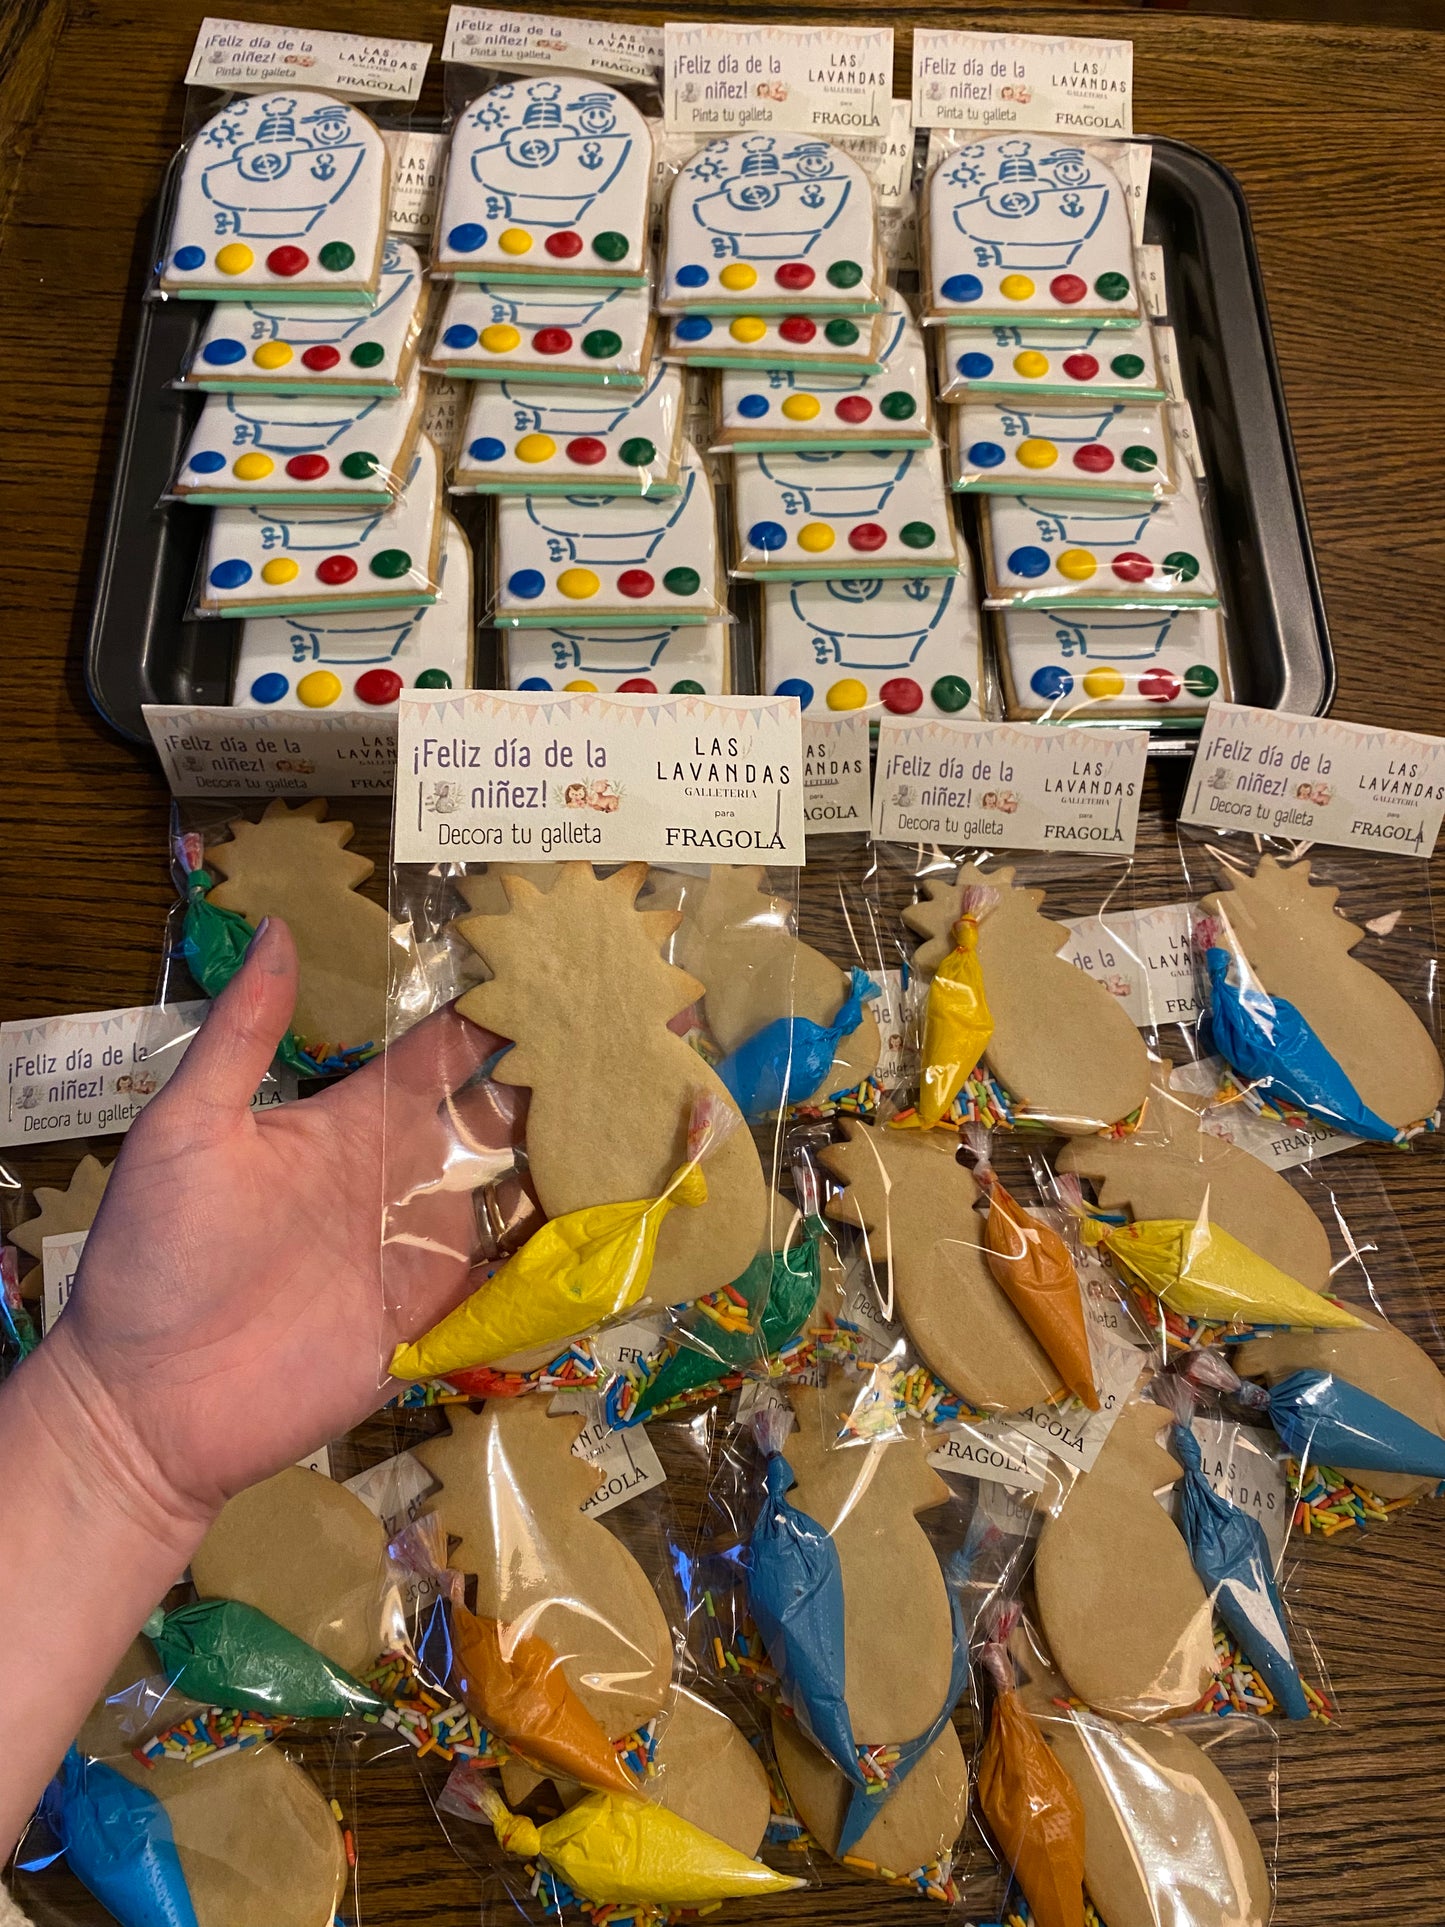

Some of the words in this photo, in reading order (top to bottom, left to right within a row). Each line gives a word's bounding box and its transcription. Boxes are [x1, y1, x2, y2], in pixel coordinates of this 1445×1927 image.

[456, 20, 494, 32] ¡Feliz
[500, 22, 520, 34] día
[528, 25, 544, 36] de
[550, 27, 562, 38] la
[611, 33, 636, 43] LAS
[205, 34, 243, 49] ¡Feliz
[250, 36, 271, 49] día
[277, 38, 294, 50] de
[301, 41, 313, 52] la
[485, 34, 528, 47] niñez!
[588, 37, 664, 57] LAVANDAS
[232, 51, 275, 64] niñez!
[339, 52, 418, 71] LAVANDAS
[364, 47, 390, 58] LAS
[470, 48, 497, 57] Pinta
[501, 49, 513, 57] tu
[516, 50, 552, 60] galleta
[831, 53, 857, 67] LAS
[215, 66, 242, 77] Pinta
[246, 68, 258, 77] tu
[261, 67, 297, 79] galleta
[674, 55, 711, 78] ¡Feliz
[718, 54, 739, 74] día
[746, 55, 763, 73] de
[769, 55, 781, 73] la
[919, 57, 956, 78] ¡Feliz
[963, 59, 984, 77] día
[990, 59, 1007, 77] de
[1014, 61, 1025, 78] la
[1074, 62, 1099, 75] LAS
[337, 75, 407, 94] FRAGOLA
[809, 69, 886, 86] LAVANDAS
[1052, 75, 1127, 93] LAVANDAS
[705, 80, 748, 99] niñez!
[950, 83, 992, 100] niñez!
[692, 108, 719, 122] Pinta
[723, 109, 735, 122] tu
[738, 108, 773, 126] galleta
[813, 111, 880, 127] FRAGOLA
[937, 105, 963, 120] Pinta
[967, 107, 979, 120] tu
[983, 107, 1017, 125] galleta
[1056, 112, 1122, 129] FRAGOLA
[165, 735, 213, 753] ¡Feliz
[221, 737, 248, 753] día
[256, 738, 276, 753] de
[284, 739, 300, 753] la
[362, 736, 396, 747] LAS
[695, 737, 739, 757] LAS
[337, 749, 397, 760] LAVAN
[413, 739, 481, 775] ¡Feliz
[495, 738, 531, 768] día
[545, 740, 573, 768] de
[587, 740, 606, 768] la
[806, 744, 826, 758] AS
[1206, 738, 1253, 762] ¡Feliz
[1258, 746, 1283, 767] día
[1291, 751, 1310, 771] de
[1317, 754, 1332, 775] la
[212, 757, 264, 773] niñez!
[657, 762, 790, 785] LAVANDAS
[804, 760, 862, 776] ANDAS
[886, 755, 931, 780] ¡Feliz
[939, 757, 964, 779] día
[972, 759, 991, 780] de
[1000, 760, 1014, 781] la
[1072, 761, 1103, 776] LAS
[1389, 761, 1418, 778] LAS
[196, 776, 241, 789] Decora
[245, 778, 261, 789] tu
[266, 777, 307, 792] galleta
[684, 787, 757, 799] GALLETERIA
[1045, 779, 1135, 796] LAVANDAS
[1236, 773, 1288, 797] niñez!
[1359, 775, 1445, 800] LAVANDAS
[471, 780, 547, 809] niñez!
[921, 788, 972, 809] niñez!
[714, 810, 735, 819] para
[803, 805, 859, 821] AGOLA
[1210, 796, 1252, 817] Decora
[1257, 804, 1270, 819] tu
[1274, 806, 1314, 828] galleta
[898, 814, 940, 831] Decora
[945, 818, 959, 833] tu
[964, 818, 1004, 839] galleta
[1044, 825, 1124, 842] FRAGOLA
[1351, 820, 1424, 843] FRAGOLA
[438, 823, 503, 845] Decora
[512, 824, 531, 844] tu
[541, 824, 601, 853] galleta
[665, 828, 786, 850] FRAGOLA
[1073, 952, 1093, 970] de
[1099, 949, 1116, 968] la
[899, 1003, 913, 1023] la
[8, 1055, 57, 1083] ¡Feliz
[66, 1048, 92, 1072] día
[102, 1045, 123, 1066] de
[133, 1042, 148, 1063] la
[49, 1076, 104, 1103] niñez!
[24, 1112, 71, 1132] Decora
[77, 1109, 92, 1125] tu
[1270, 1127, 1336, 1156] FRAGO
[1018, 1406, 1085, 1453] AGOLA
[1203, 1458, 1237, 1480] LAS
[580, 1467, 649, 1511] AGOLA
